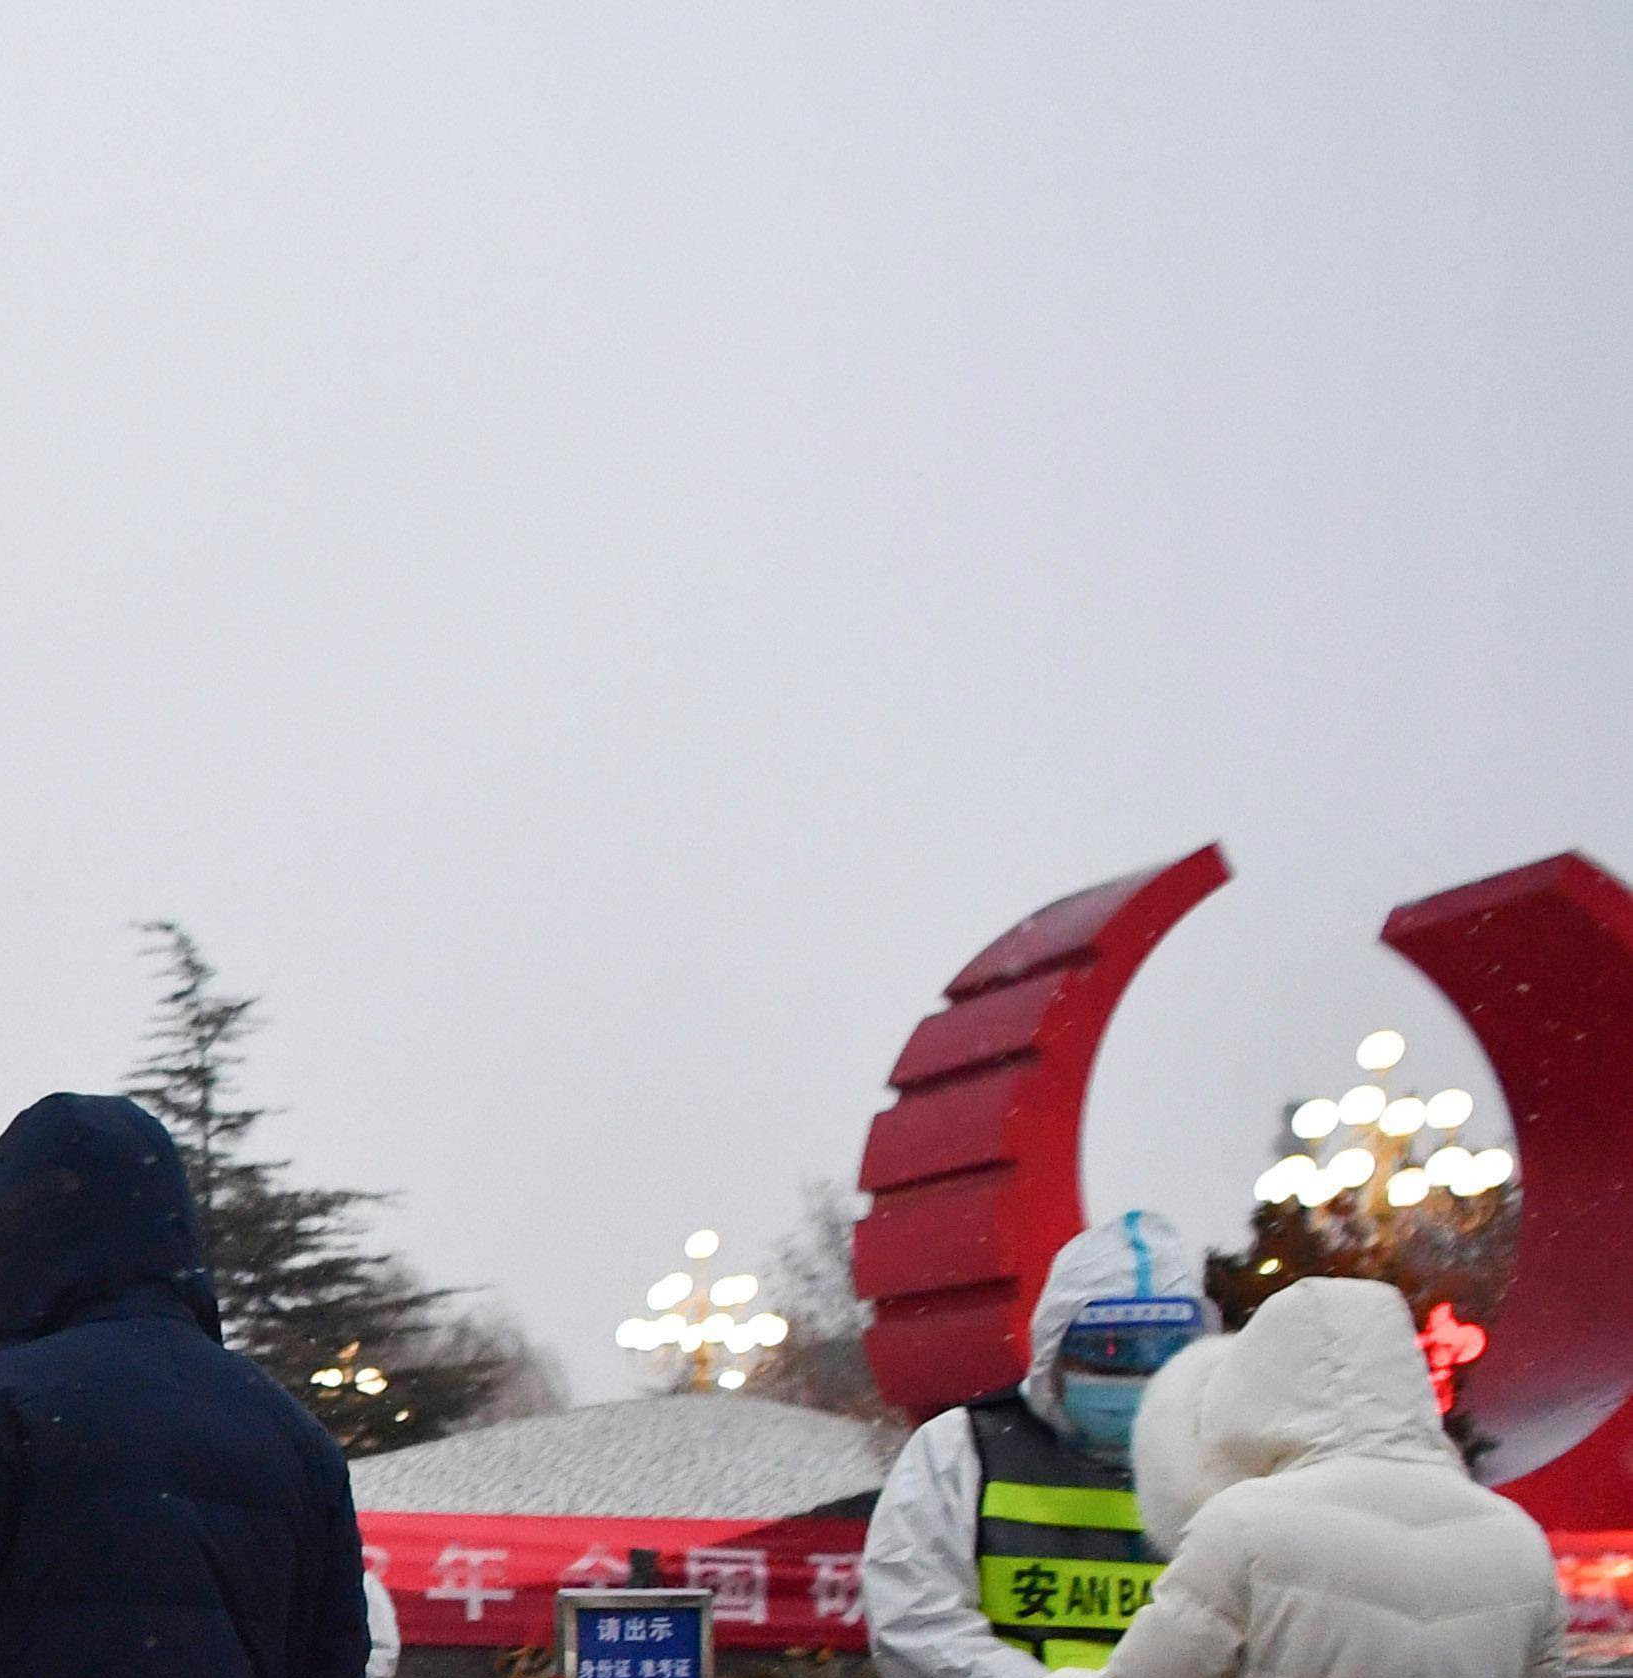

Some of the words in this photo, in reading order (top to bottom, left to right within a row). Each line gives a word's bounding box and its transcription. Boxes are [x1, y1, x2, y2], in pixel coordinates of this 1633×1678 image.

[1011, 1562, 1059, 1619] 安
[1064, 1576, 1111, 1616] AN
[596, 1616, 675, 1643] 请出示
